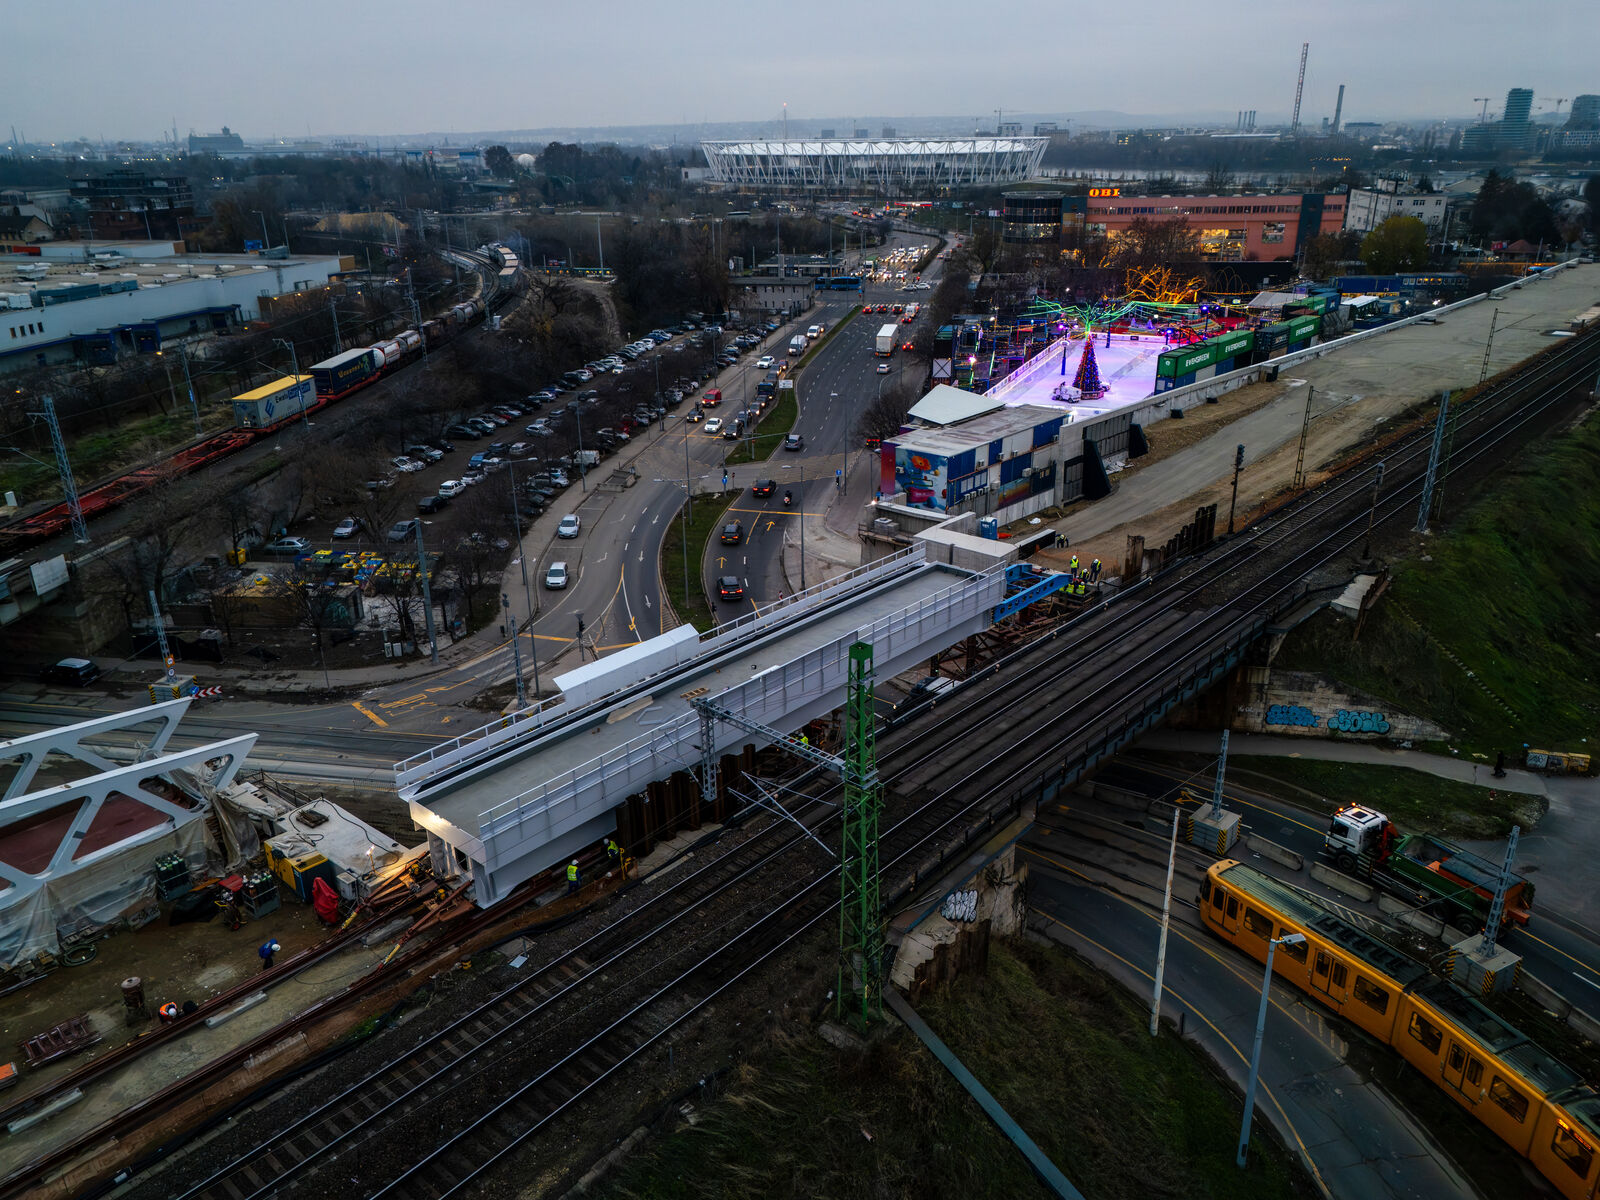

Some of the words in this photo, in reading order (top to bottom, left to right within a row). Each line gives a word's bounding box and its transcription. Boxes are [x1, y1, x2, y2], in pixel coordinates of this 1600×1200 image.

[1089, 188, 1120, 197] OBI
[1225, 339, 1248, 353] EVERGREEN
[1185, 352, 1210, 367] EVERGREEN
